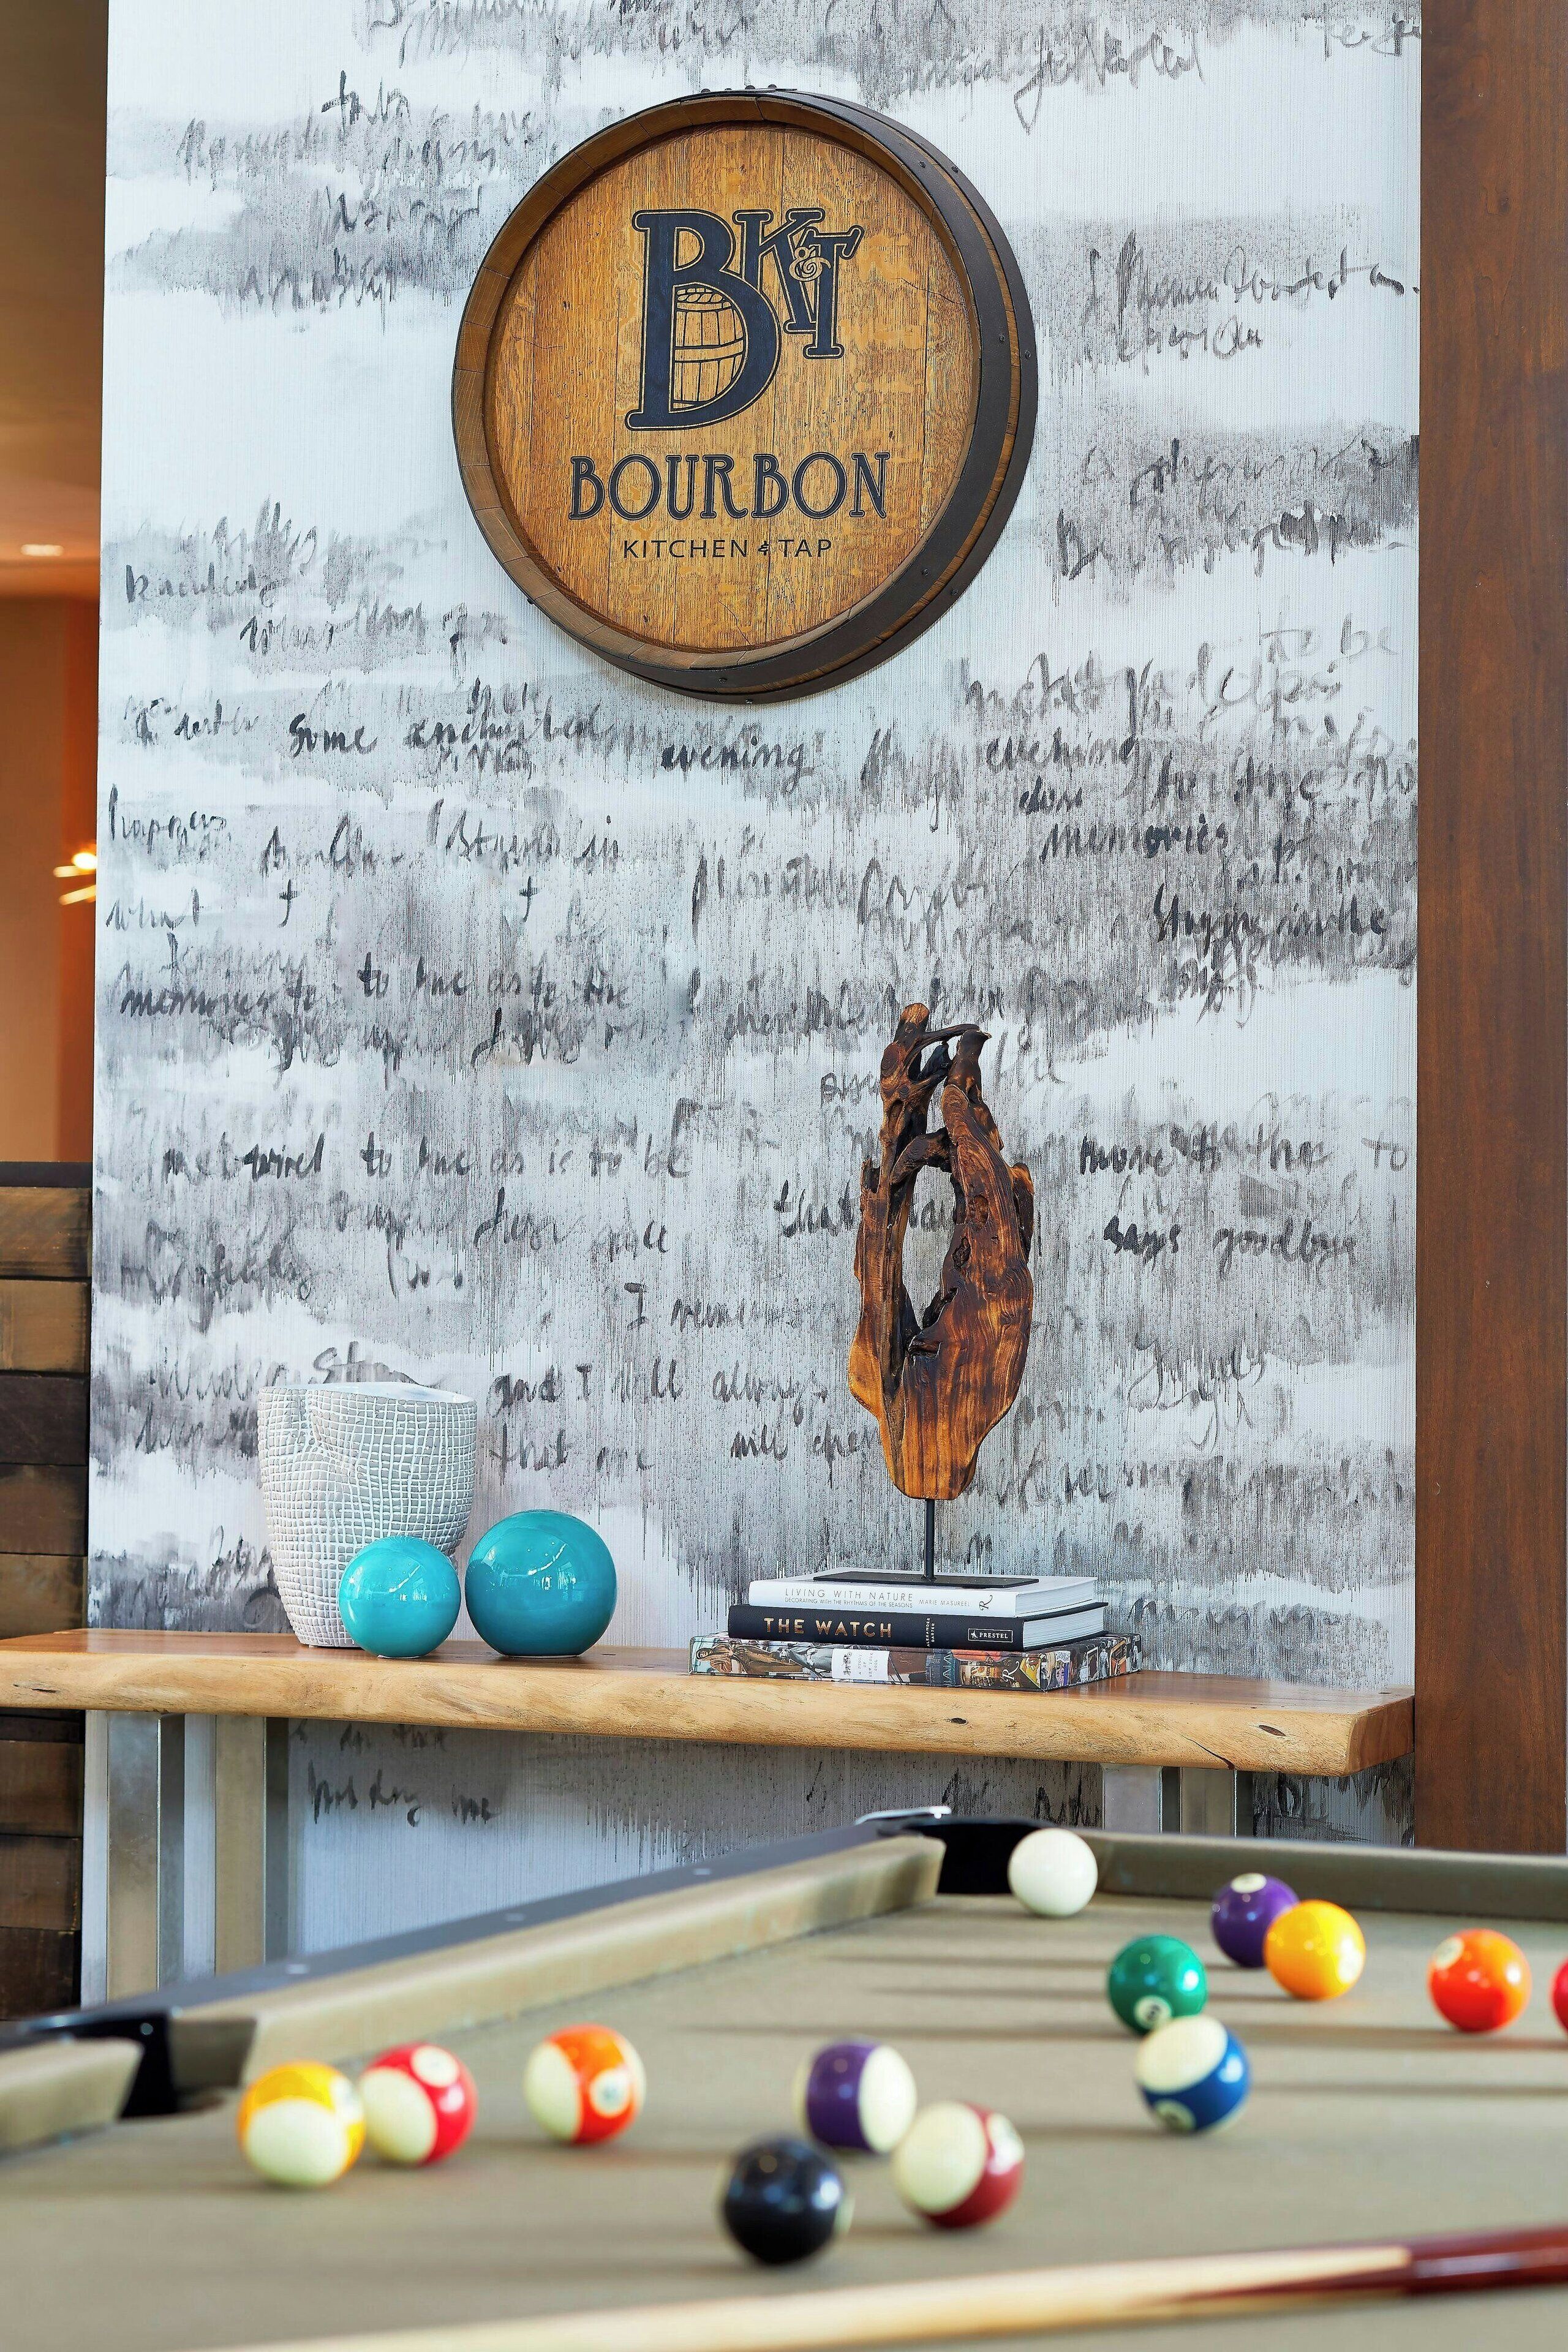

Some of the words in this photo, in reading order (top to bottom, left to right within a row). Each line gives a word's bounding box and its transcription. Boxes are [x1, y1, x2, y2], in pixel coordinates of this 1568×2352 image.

[568, 452, 891, 521] BOURBON
[623, 539, 748, 559] KITCHEN
[757, 540, 770, 556] &
[778, 538, 832, 558] TAP
[660, 733, 815, 795] evening
[785, 1588, 826, 1598] LIVING
[833, 1590, 862, 1599] WITH
[869, 1592, 913, 1602] NATURE
[763, 1617, 805, 1634] THE
[815, 1619, 892, 1638] WATCH
